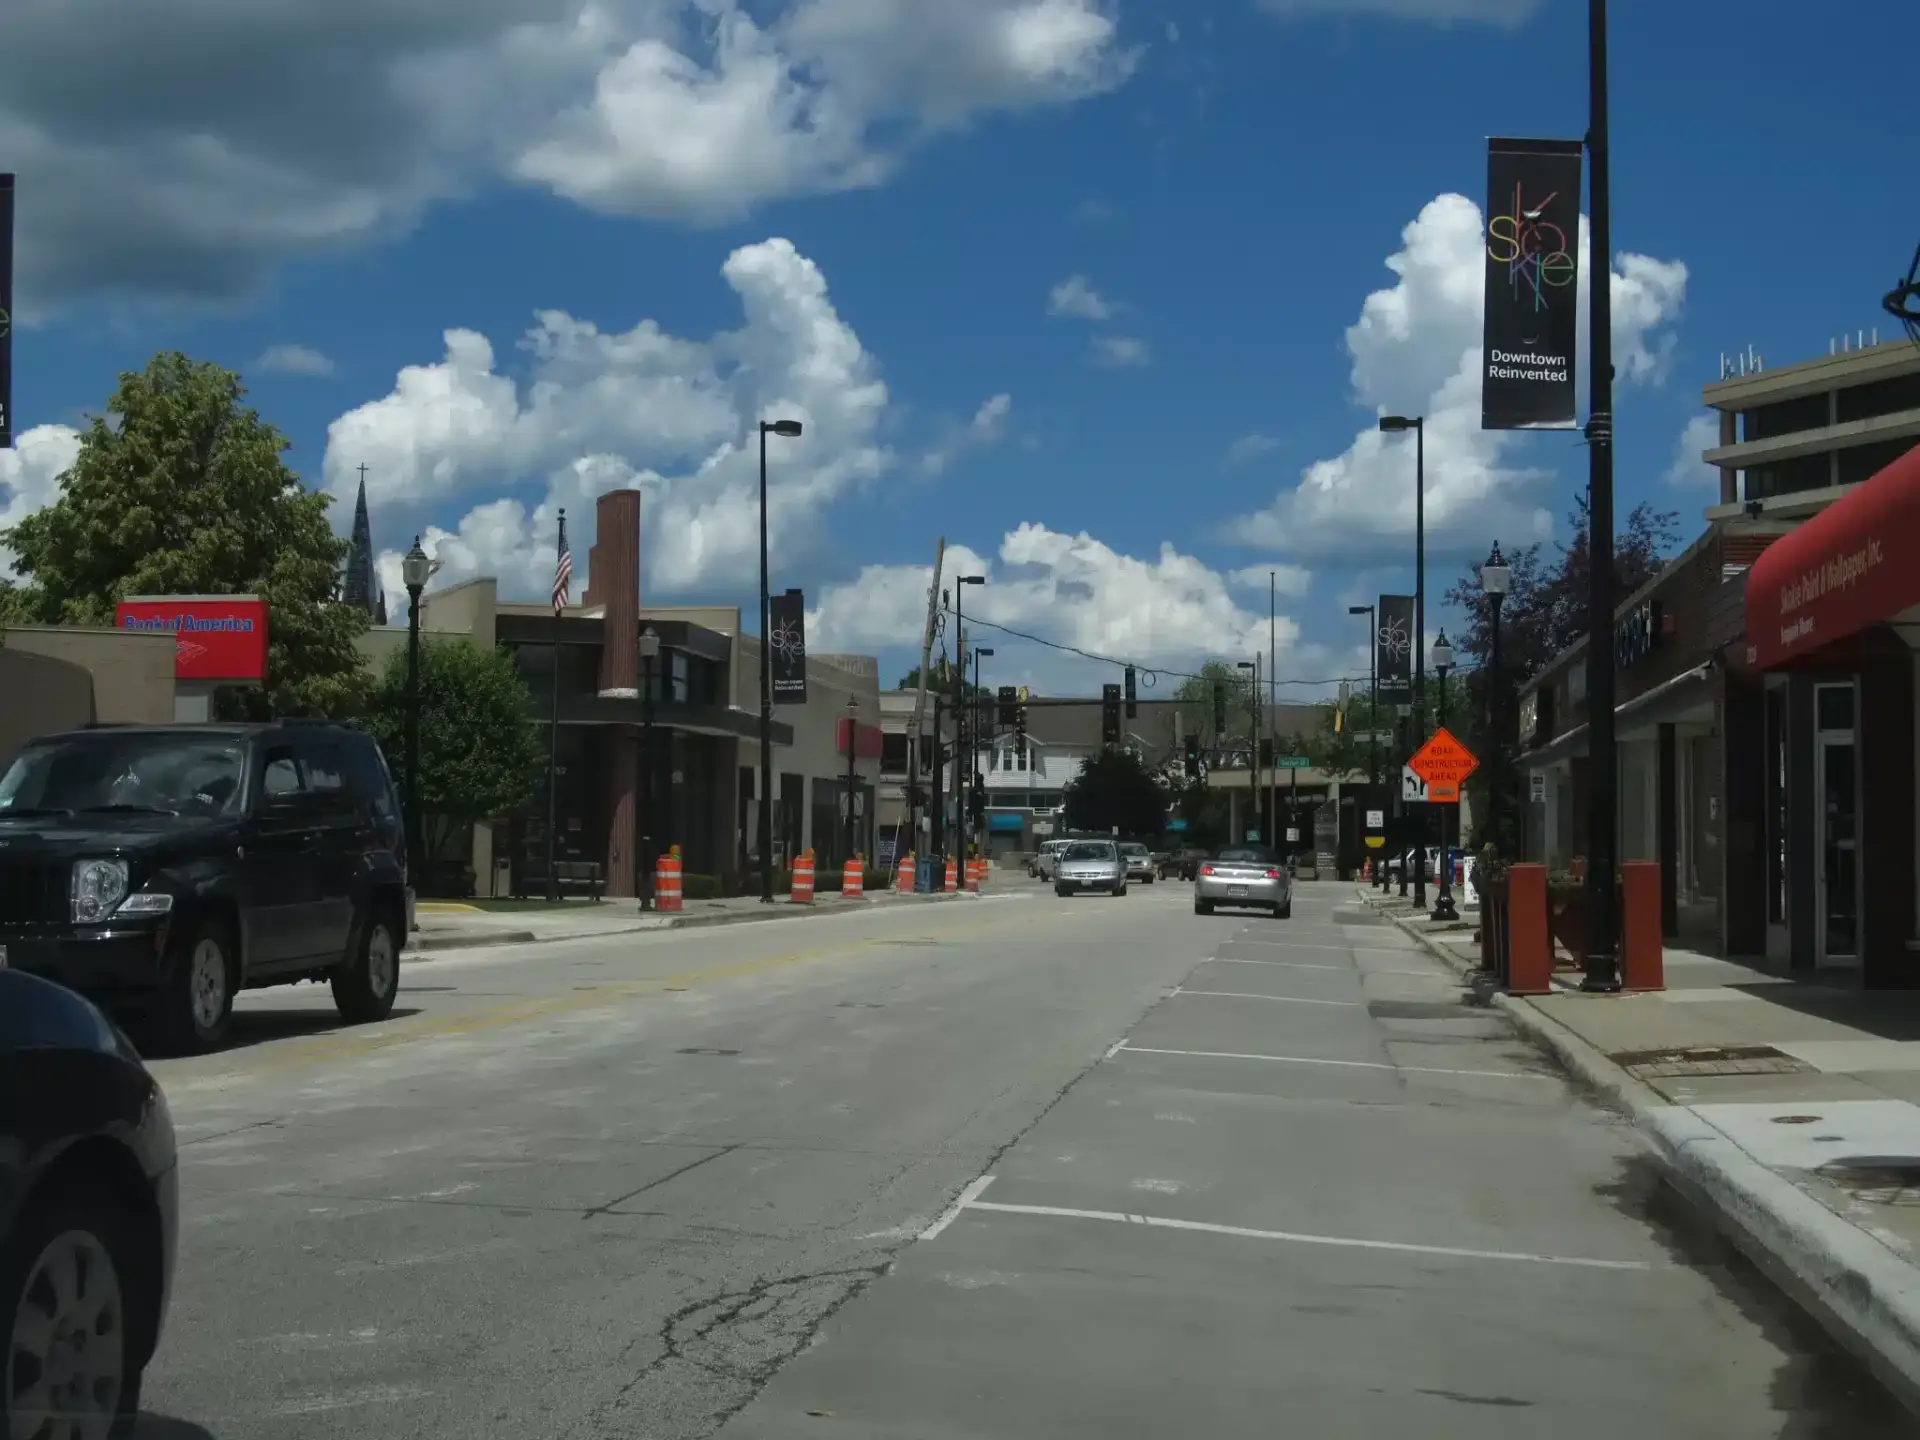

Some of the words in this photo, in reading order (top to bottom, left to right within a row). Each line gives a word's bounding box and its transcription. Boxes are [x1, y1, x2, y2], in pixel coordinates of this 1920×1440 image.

[1491, 349, 1567, 366] Downtown
[1488, 365, 1568, 382] Reinvented
[1802, 569, 1820, 602] Paint
[1827, 549, 1867, 593] Wallpaper,
[1868, 536, 1883, 569] Inc.
[124, 615, 167, 630] Bank
[168, 614, 183, 631] of
[184, 614, 254, 632] America
[1430, 746, 1454, 756] ROAD
[1414, 759, 1473, 769] CONSTRUCTION
[1429, 771, 1457, 781] AHEAD
